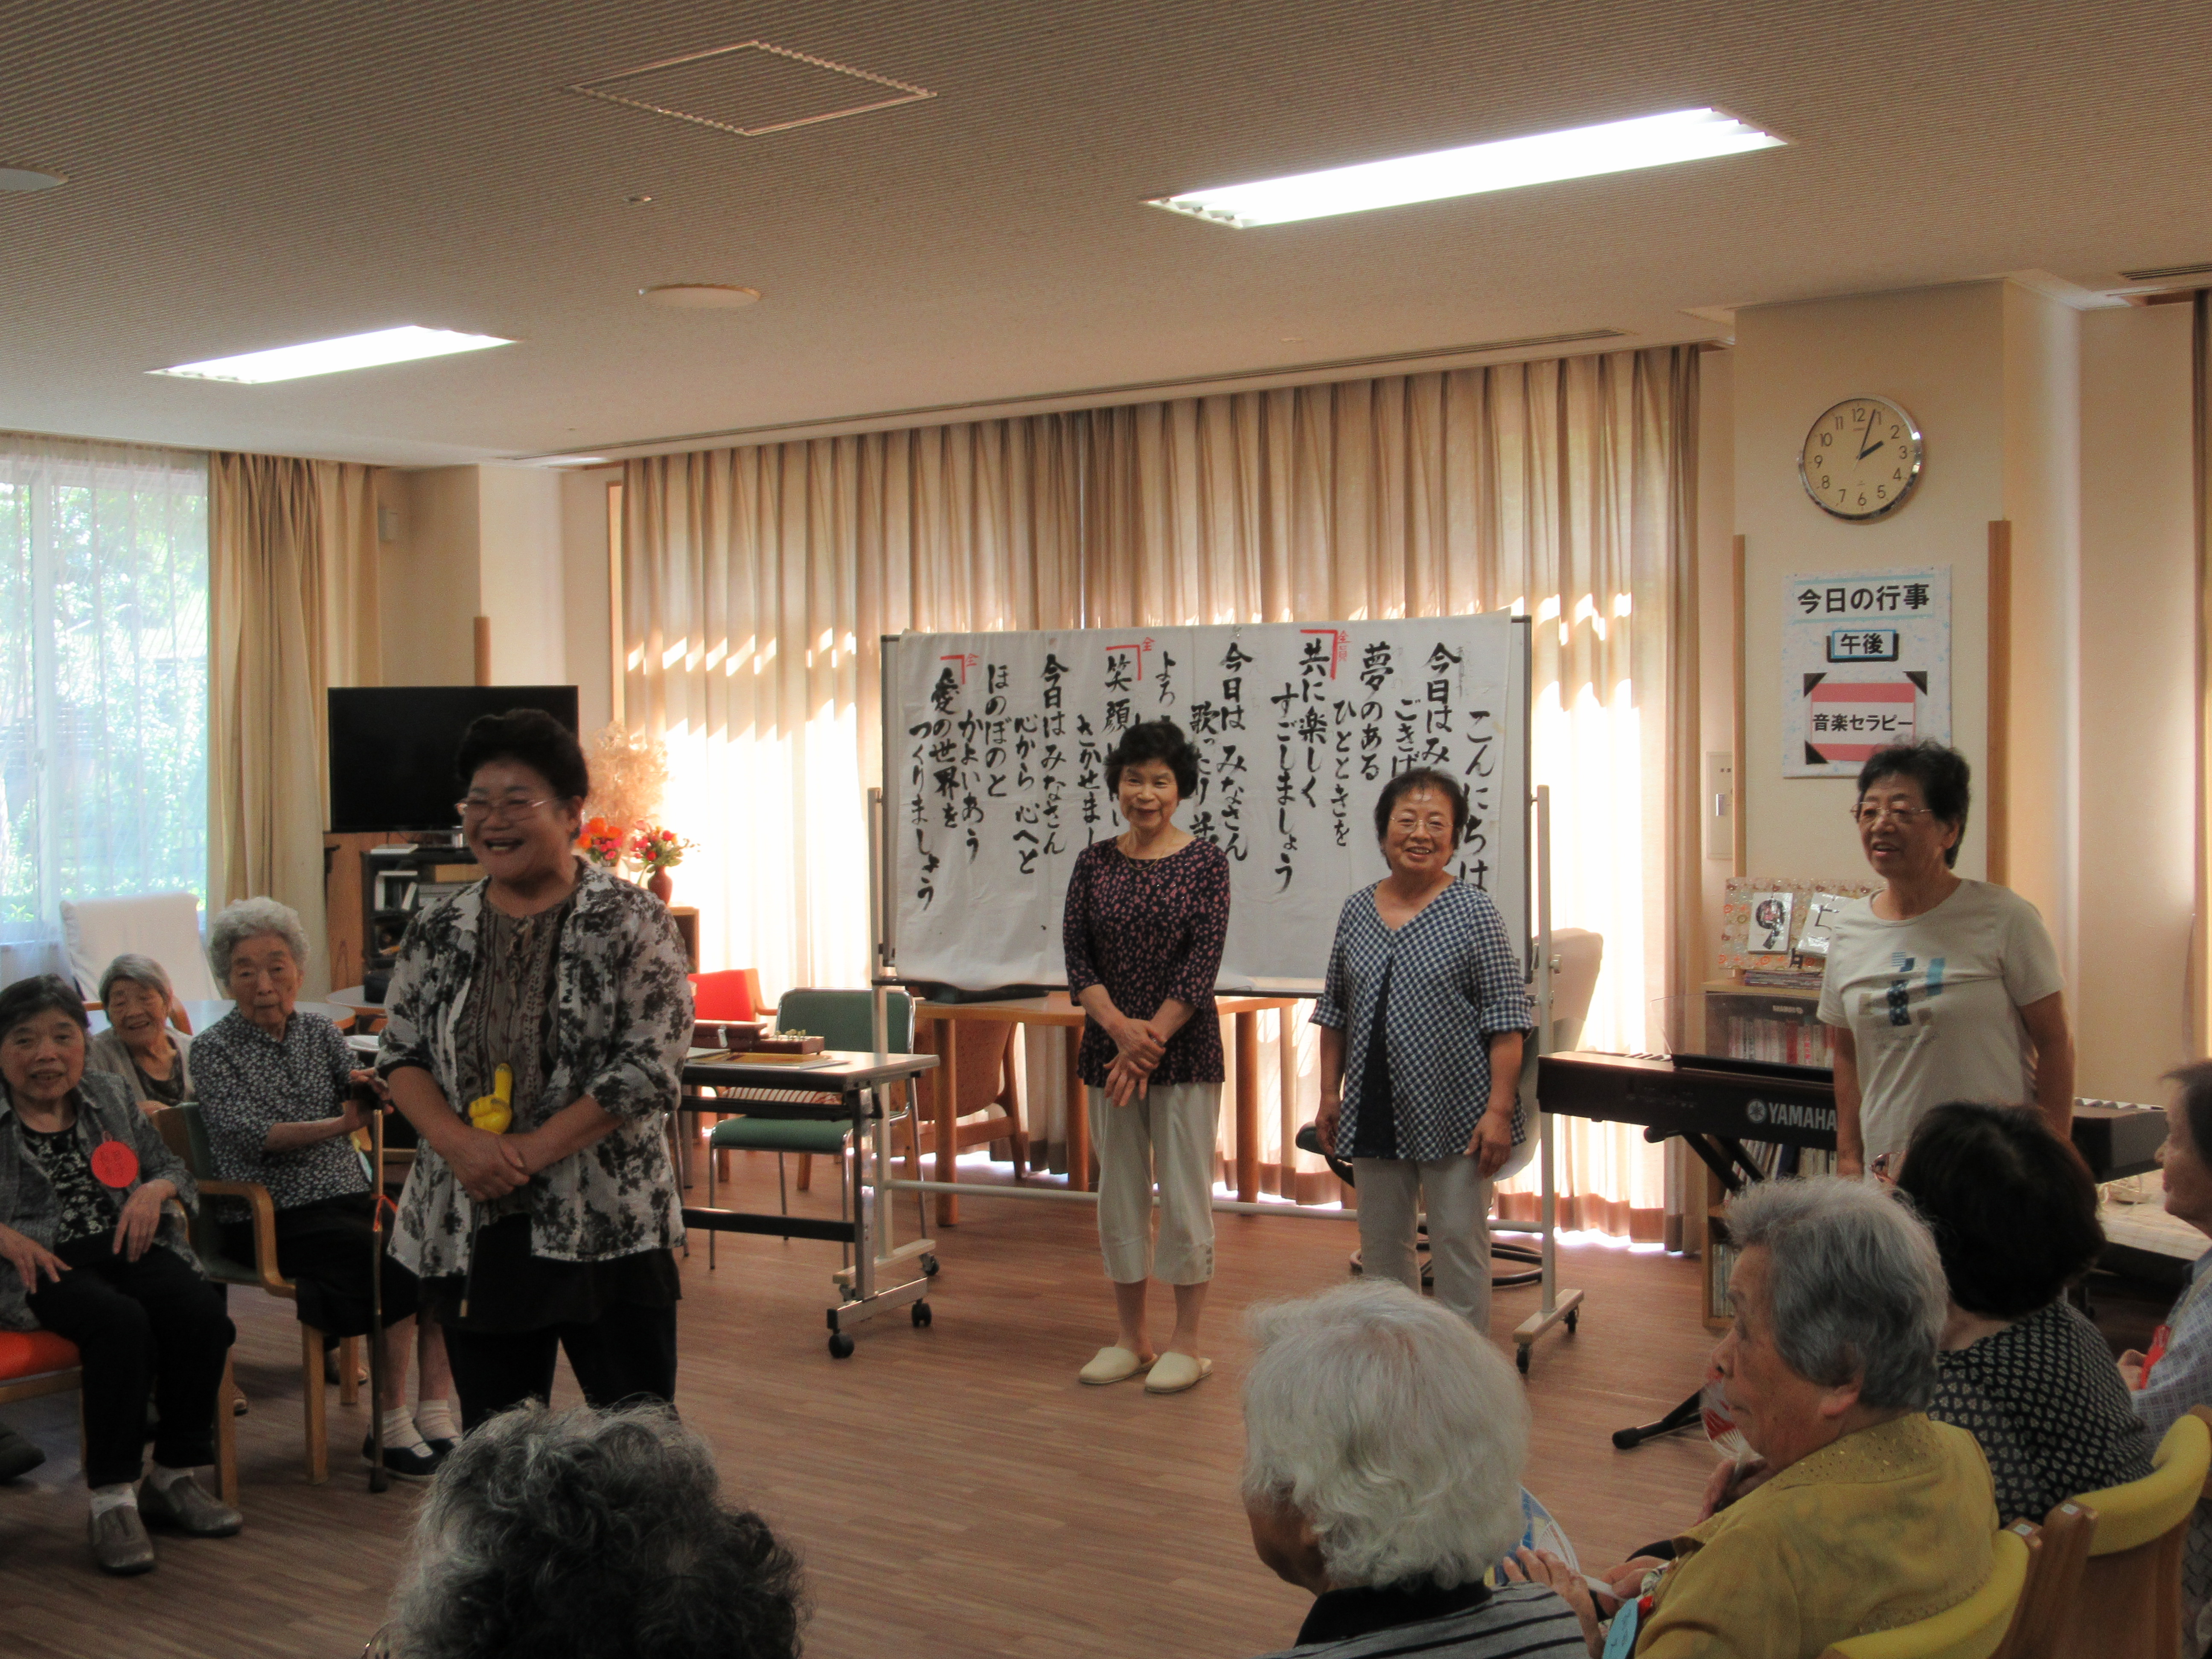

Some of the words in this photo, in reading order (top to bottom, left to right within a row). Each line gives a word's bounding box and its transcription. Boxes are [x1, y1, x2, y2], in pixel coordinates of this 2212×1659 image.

[1835, 416, 1843, 430] 11
[1851, 408, 1865, 422] 12
[1877, 411, 1882, 425] 1
[1819, 432, 1833, 447] 10
[1891, 425, 1900, 439] 2
[1814, 455, 1823, 469] 9
[1899, 445, 1907, 460] 3
[1821, 475, 1831, 489] 8
[1892, 467, 1901, 481] 4
[1839, 489, 1846, 503] 7
[1858, 492, 1867, 506] 6
[1877, 485, 1886, 498] 5
[1797, 583, 1930, 614] 今日の行事
[1143, 637, 1155, 651] 全
[1839, 633, 1884, 655] 午後
[966, 653, 978, 667] 全
[1156, 651, 1176, 722] よろ
[1360, 640, 1394, 780] 夢のある
[1423, 642, 1462, 771] 今日はみ
[985, 664, 1011, 797] ほのぼのと
[1298, 638, 1330, 807] 共に楽しく
[1813, 713, 1913, 732] 音楽セラピー
[929, 667, 960, 828] 愛の世界を
[1041, 654, 1068, 854] 今日はみなさん
[1331, 700, 1357, 847] ひとときを
[958, 710, 984, 864] かよいあう
[1271, 682, 1299, 894] すごしましょう
[1460, 710, 1494, 892] こんにちは
[909, 721, 940, 911] つくりましょう
[1756, 899, 1785, 949] 9
[1768, 1102, 1837, 1131] YAMAHA
